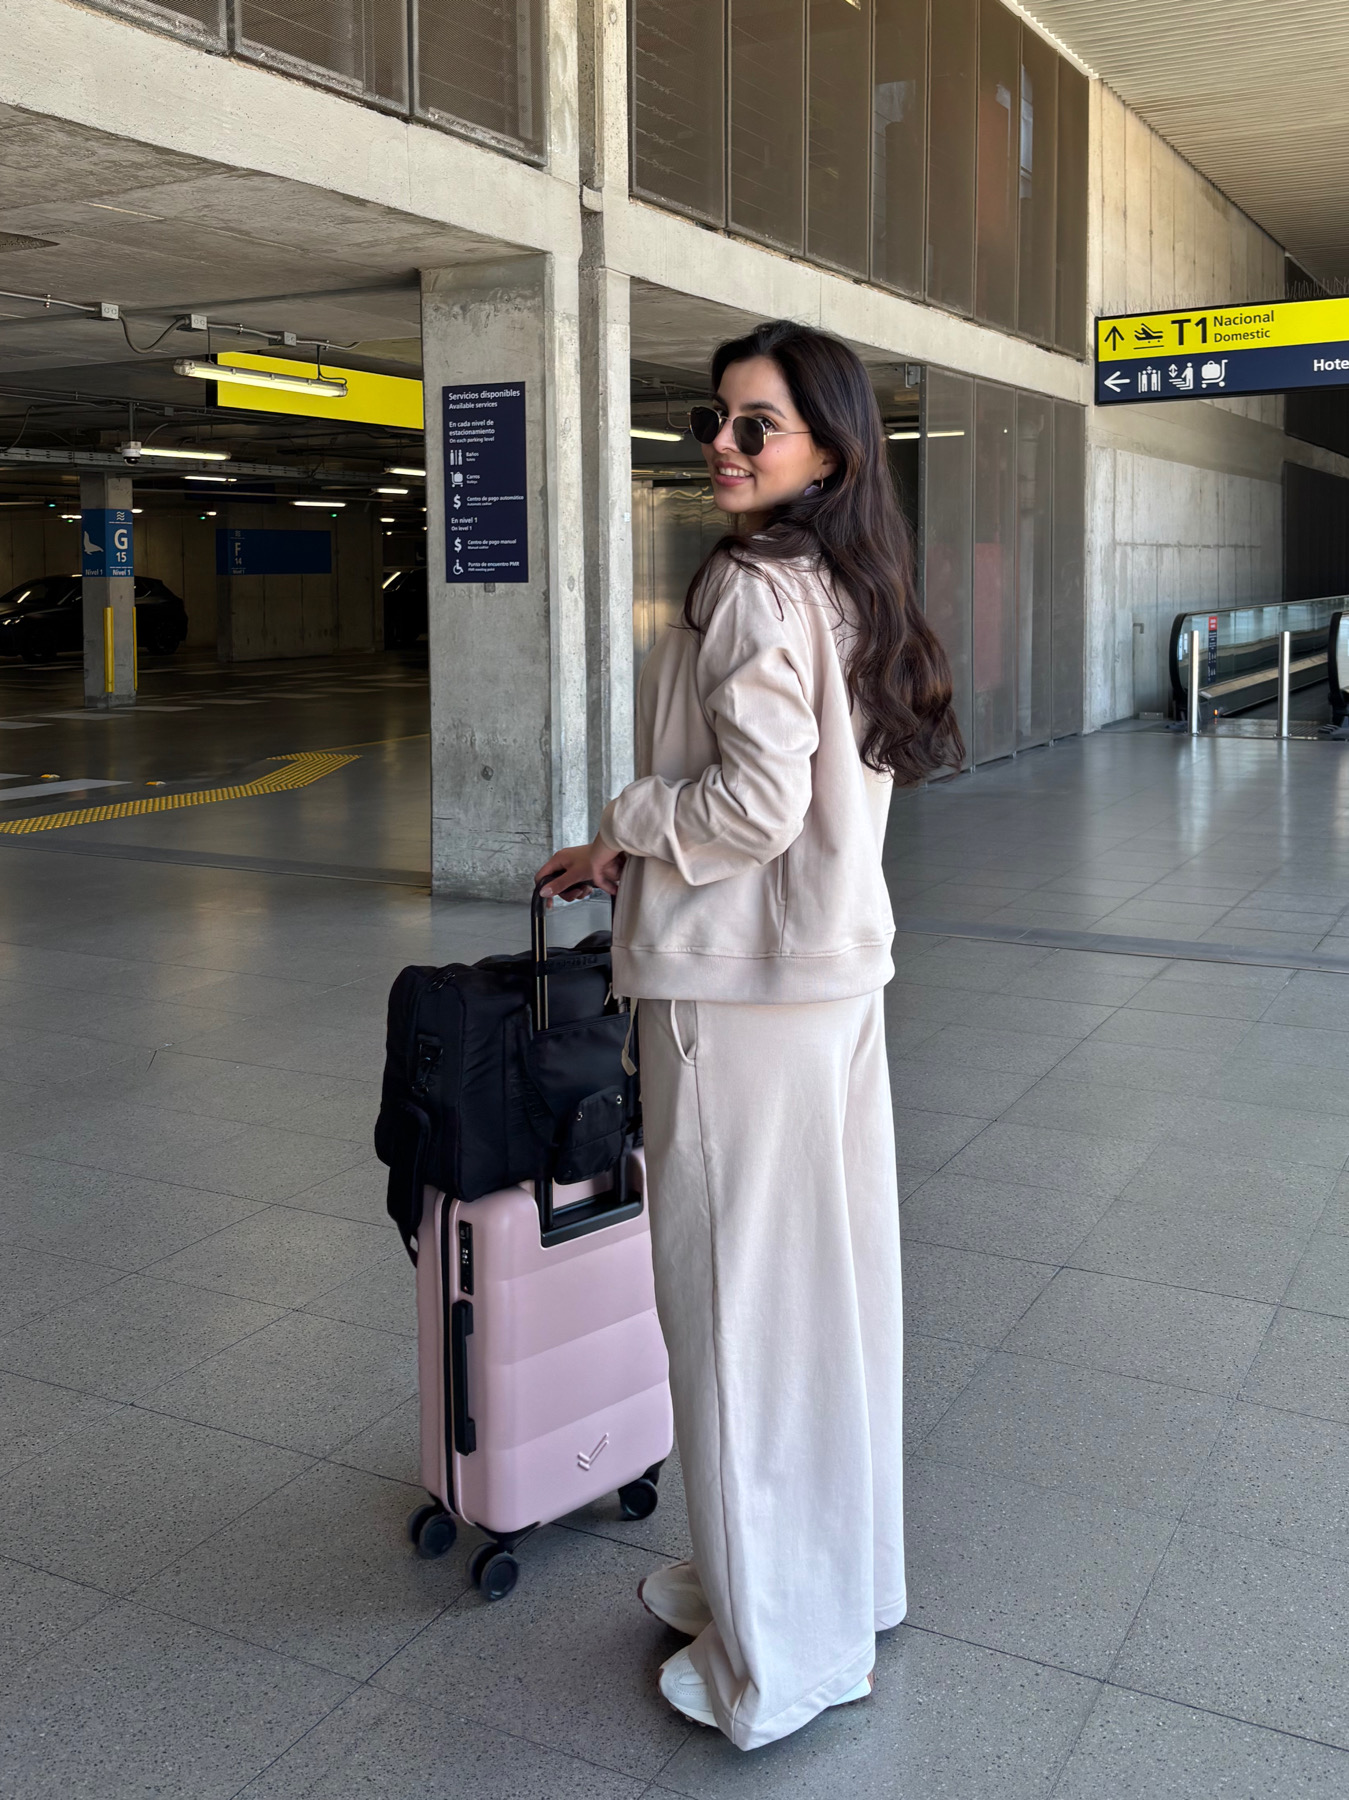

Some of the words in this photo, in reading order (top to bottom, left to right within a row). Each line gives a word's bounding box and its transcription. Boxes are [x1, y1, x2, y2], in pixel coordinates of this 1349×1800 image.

[1213, 309, 1274, 327] Nacional
[1170, 317, 1207, 346] T1
[1214, 328, 1271, 343] Domestic
[448, 392, 480, 400] Servicios
[480, 389, 520, 400] disponibles
[114, 528, 128, 550] G
[235, 542, 241, 556] F
[116, 552, 127, 563] 15
